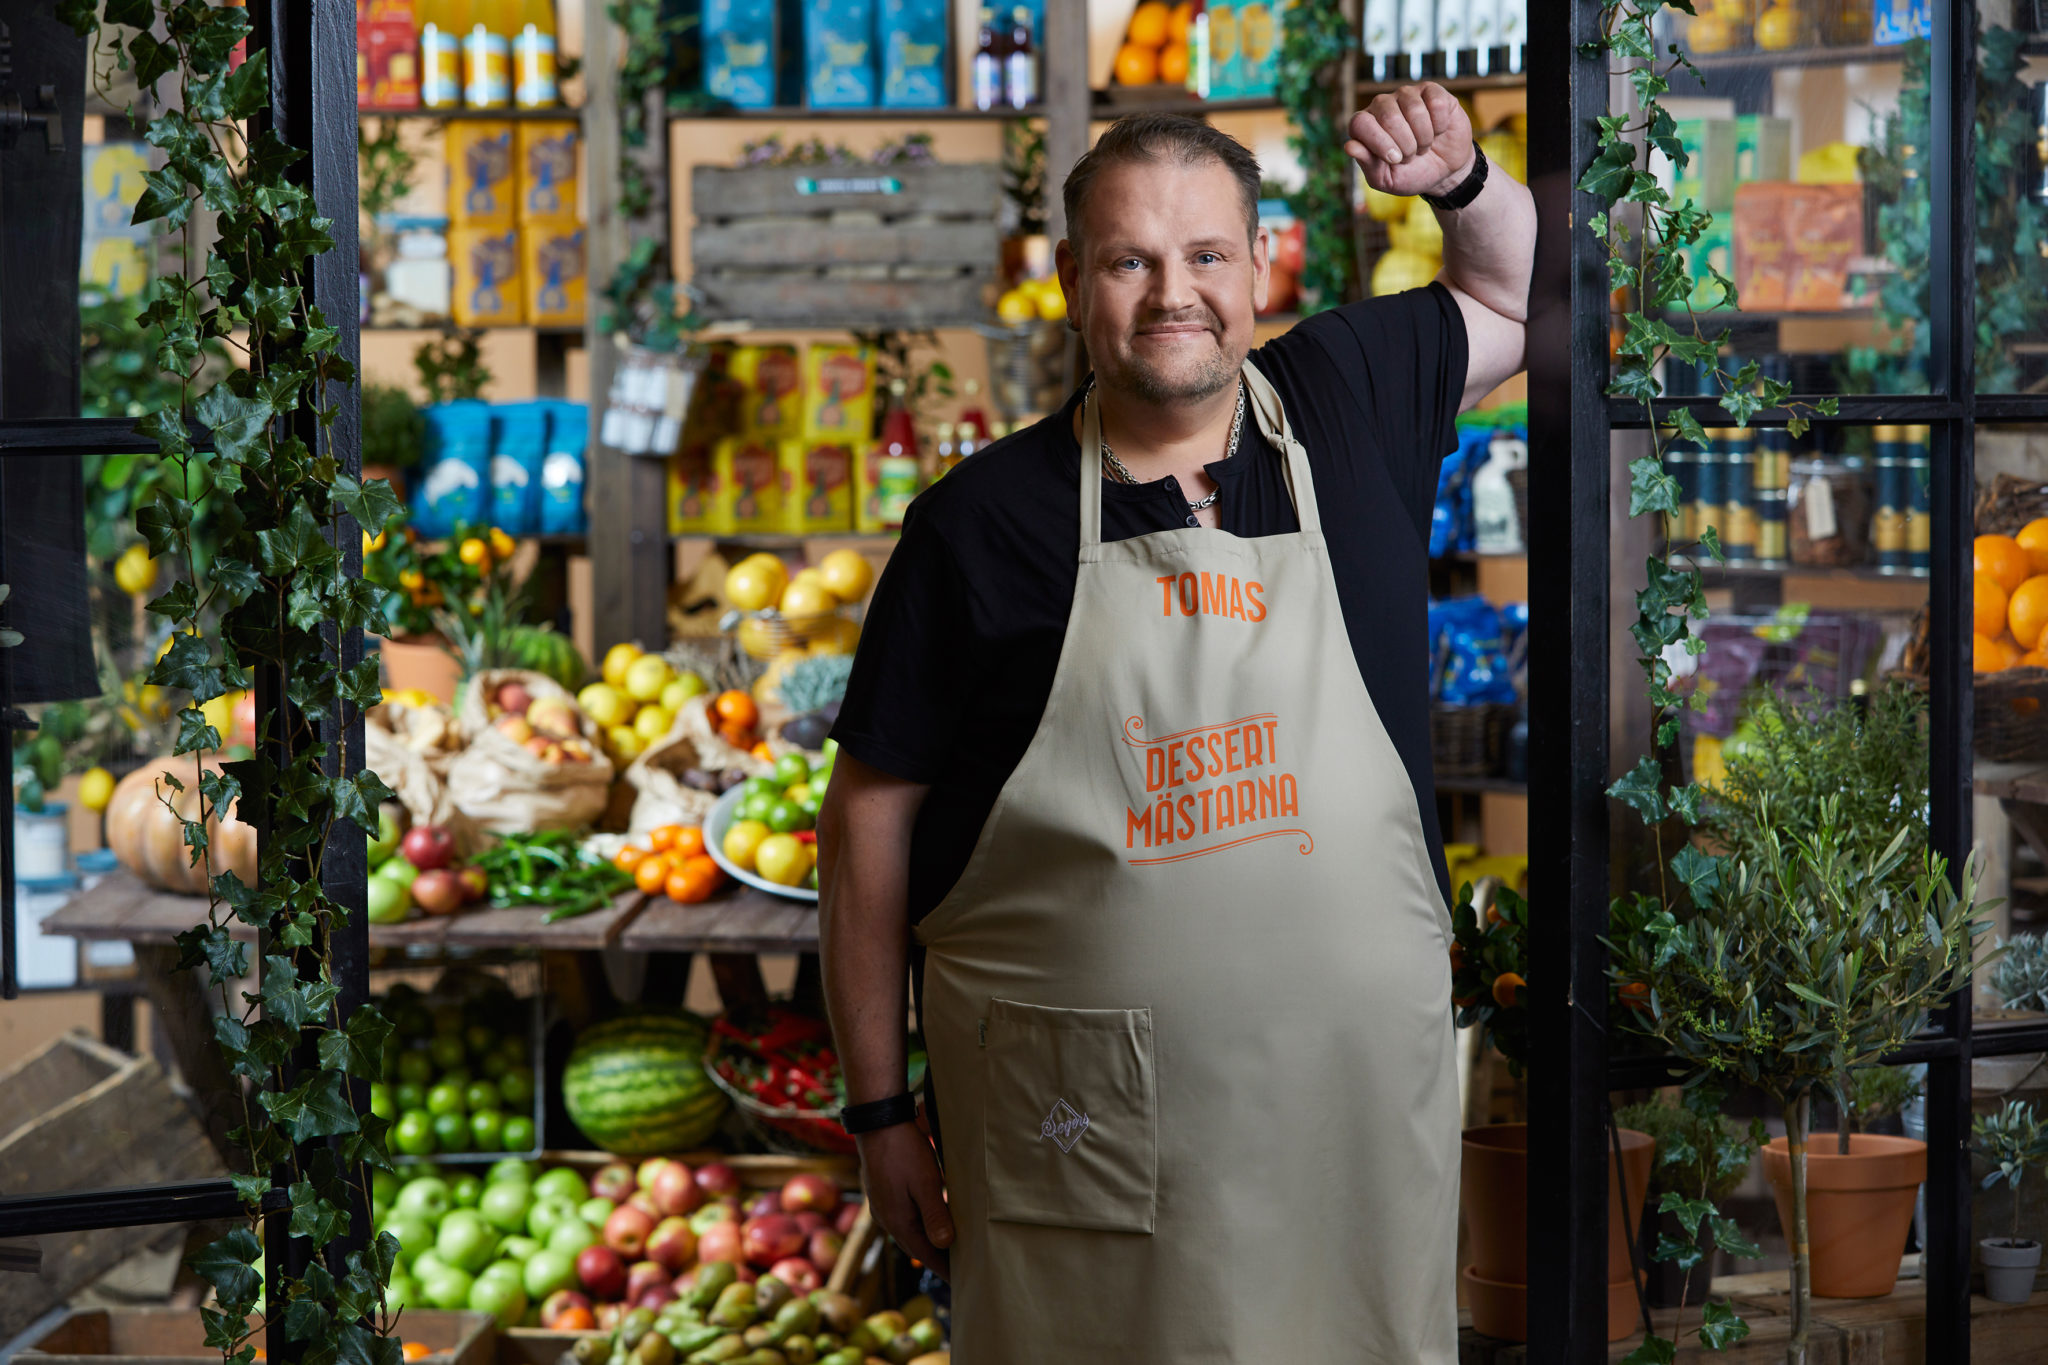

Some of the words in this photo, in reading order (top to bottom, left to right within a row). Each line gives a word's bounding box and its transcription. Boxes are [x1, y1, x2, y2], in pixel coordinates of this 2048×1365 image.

[1156, 571, 1267, 623] TOMAS
[1146, 721, 1278, 793] DESSERT
[1126, 773, 1299, 849] MÄSTARNA
